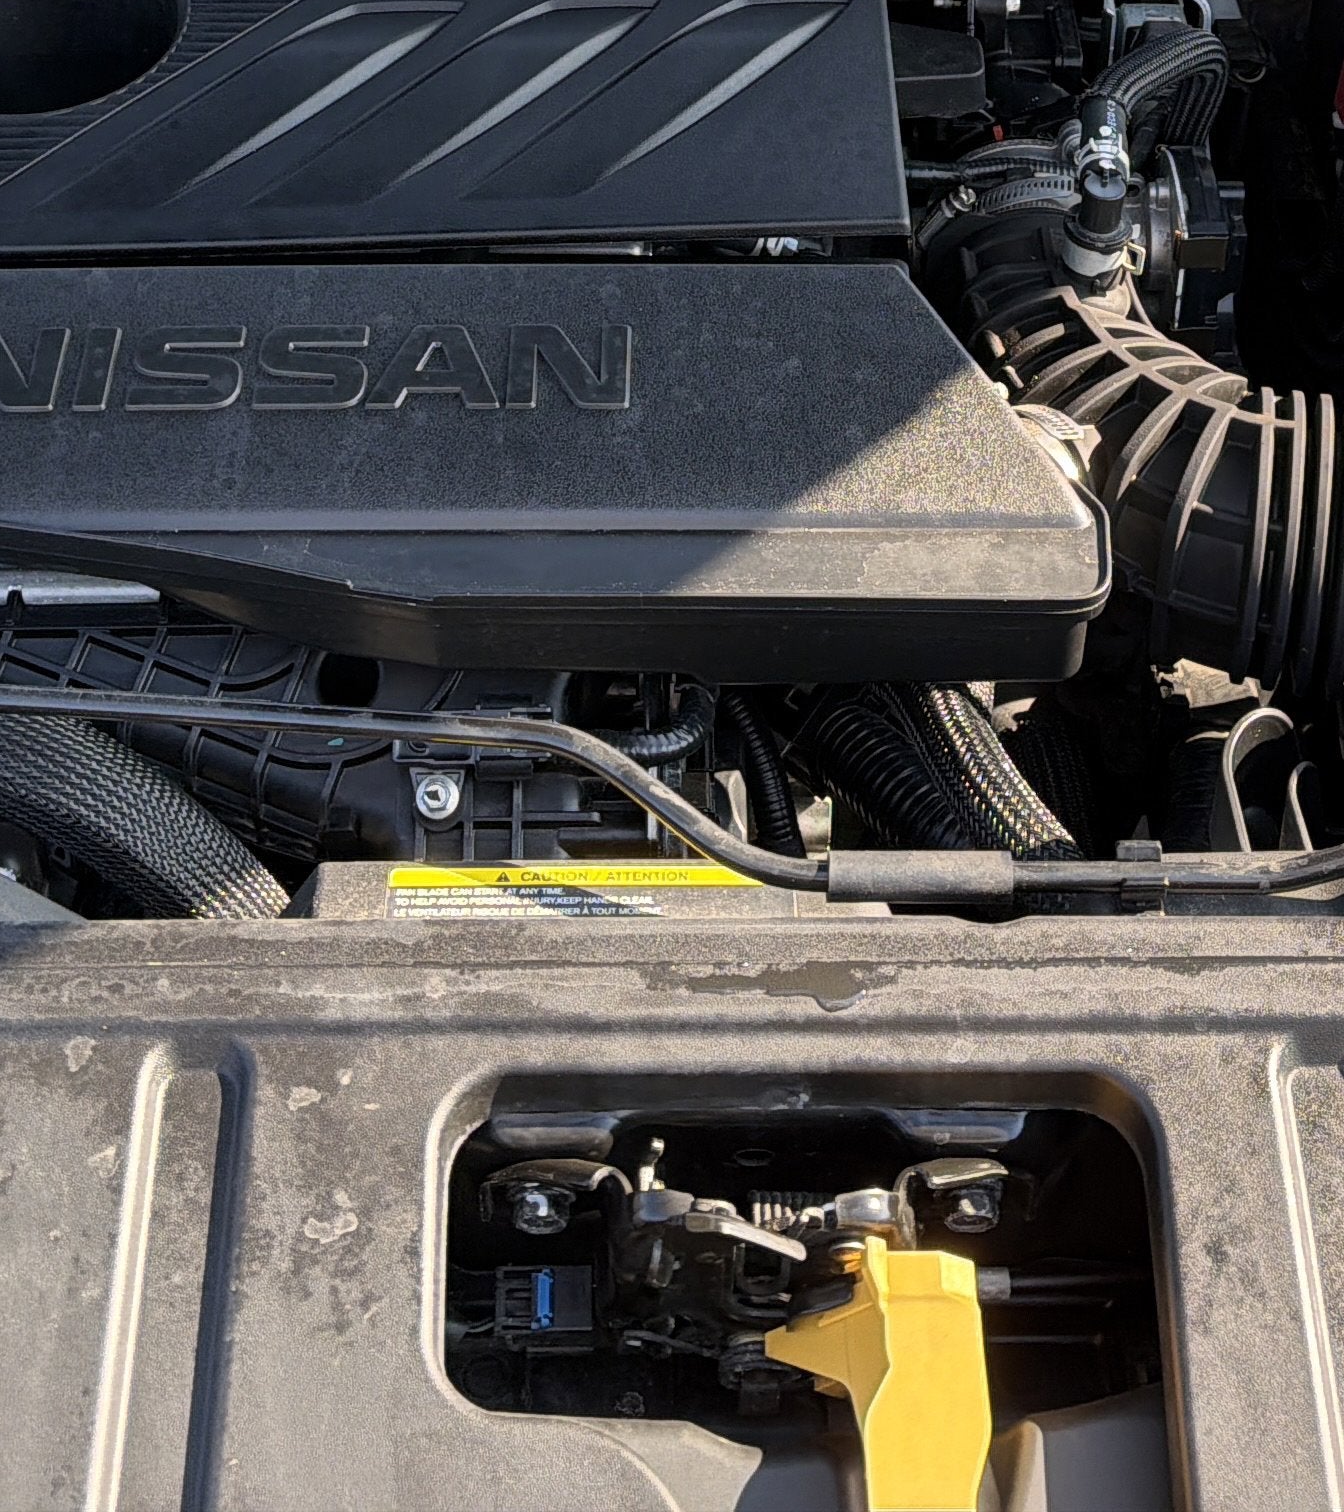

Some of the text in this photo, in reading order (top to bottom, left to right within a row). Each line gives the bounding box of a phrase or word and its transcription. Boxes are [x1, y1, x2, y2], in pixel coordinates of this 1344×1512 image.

[520, 871, 589, 882] CAUTION
[606, 871, 689, 882] ATTENTION
[417, 888, 449, 896] BLADE
[450, 888, 472, 896] CAN
[506, 887, 518, 896] AT
[519, 887, 540, 895] ANY
[396, 898, 409, 906] TO
[411, 898, 436, 906] HELP
[437, 898, 468, 906] AVOID
[510, 908, 524, 916] DE
[591, 907, 616, 915] TOUT
